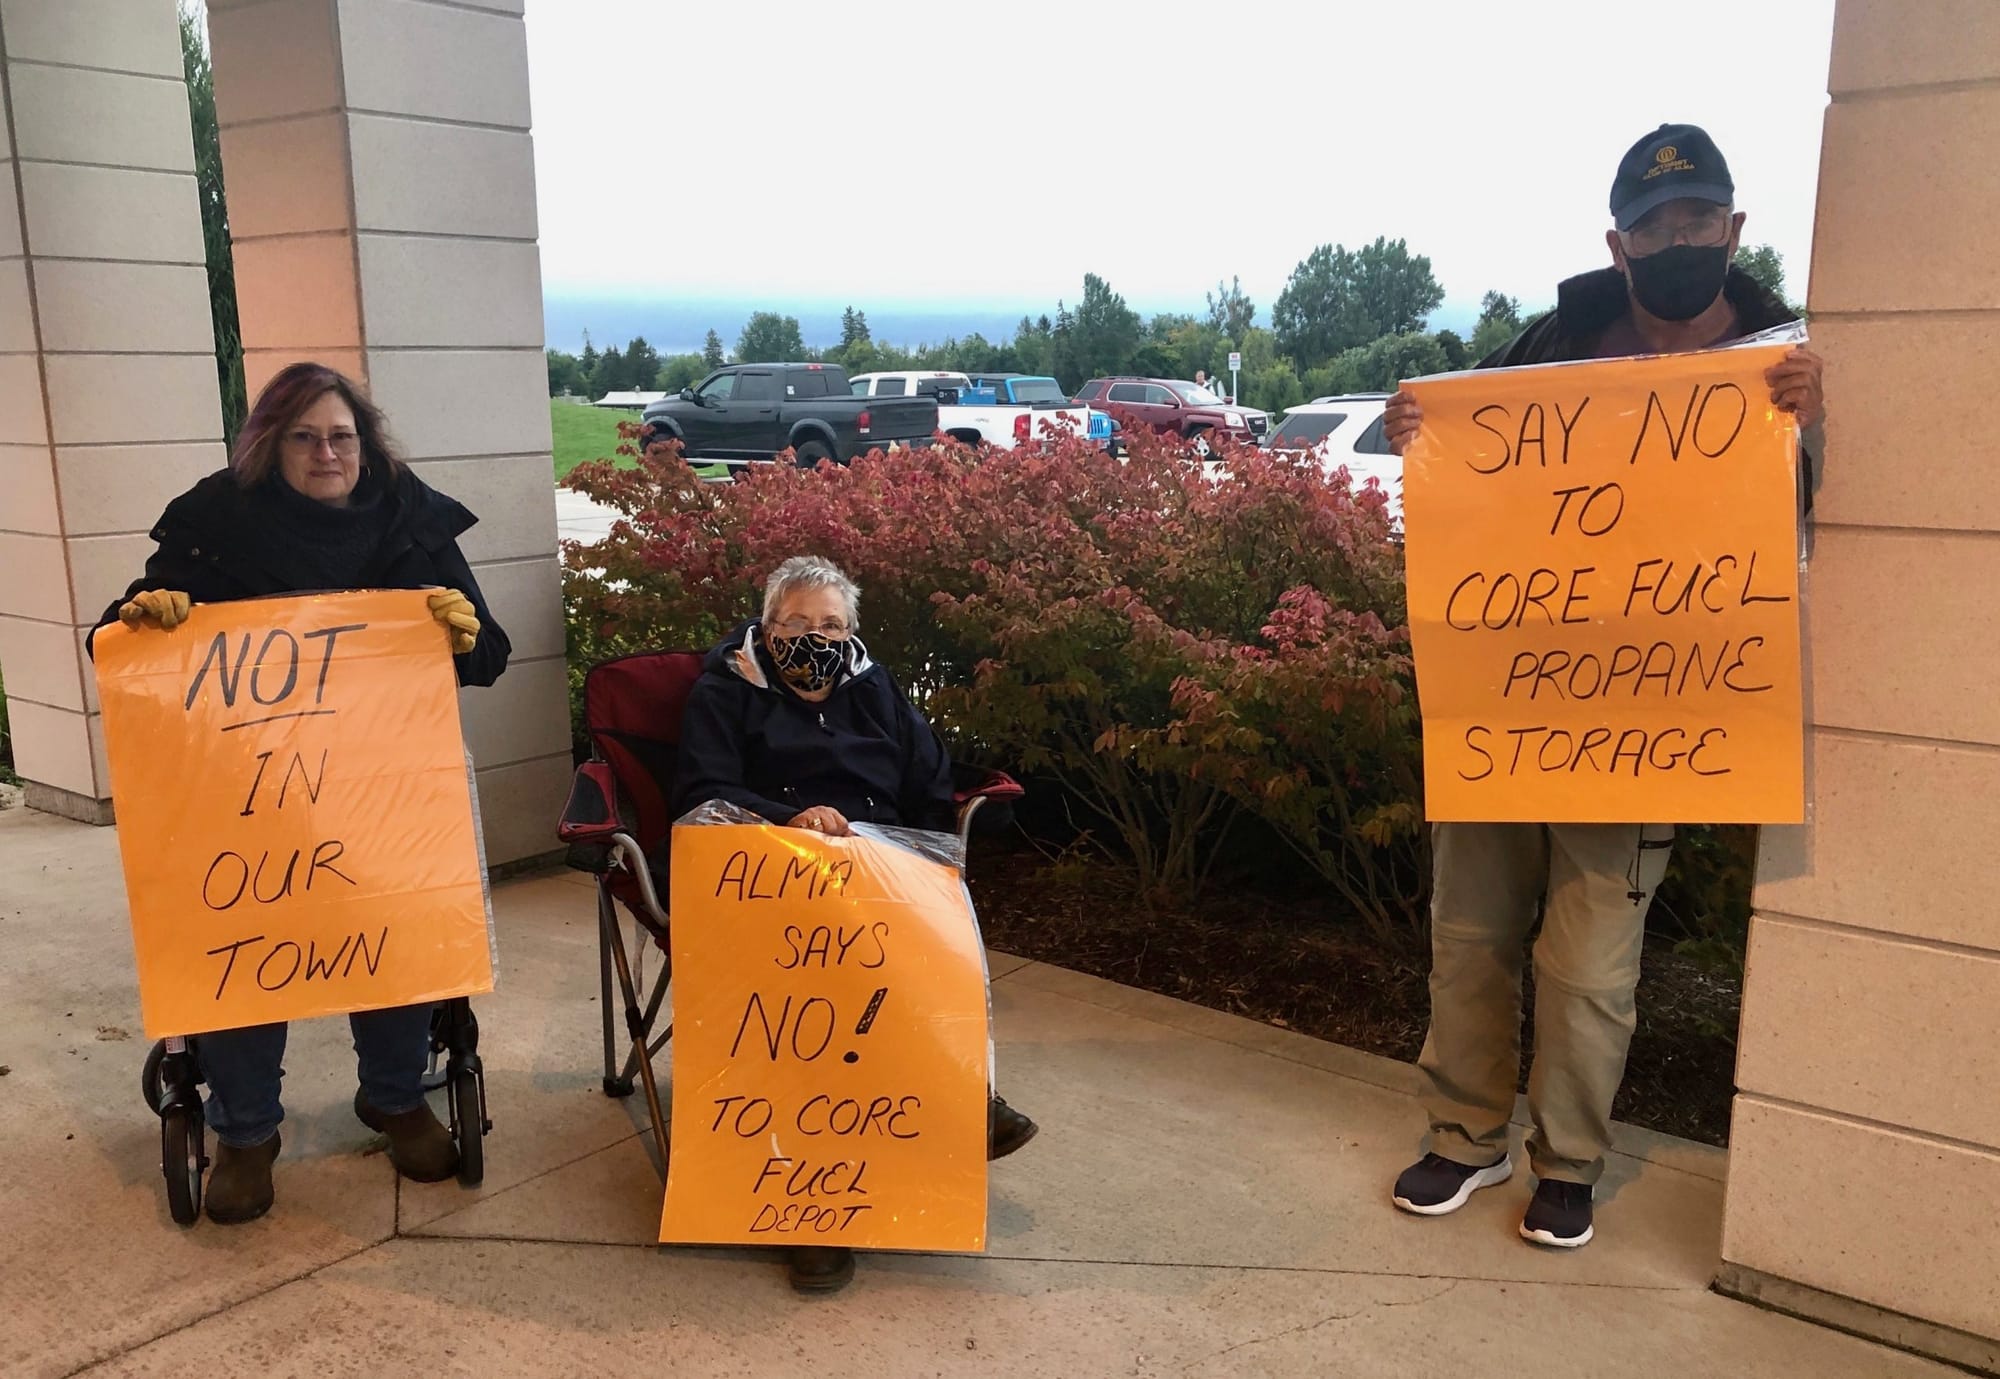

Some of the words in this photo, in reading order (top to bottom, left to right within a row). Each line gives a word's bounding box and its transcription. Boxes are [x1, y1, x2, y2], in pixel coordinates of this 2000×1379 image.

[1466, 397, 1590, 474] SAY
[1630, 383, 1746, 464] NO
[1551, 483, 1624, 536] TO
[1446, 567, 1595, 631] CORE
[1624, 551, 1790, 617] FUEL
[185, 623, 367, 711] NOT
[1504, 636, 1773, 700] PROPANE
[240, 749, 327, 816] IN
[1458, 726, 1731, 781] STORAGE
[203, 840, 356, 910] OUR
[716, 851, 853, 901] ALMA
[207, 927, 388, 1000] TOWN
[775, 922, 888, 969] SAYS
[731, 987, 888, 1063] NO!
[712, 1096, 772, 1138] TO
[797, 1095, 920, 1139] CORE
[753, 1158, 867, 1196] FUEL
[749, 1204, 872, 1233] DEPOT
